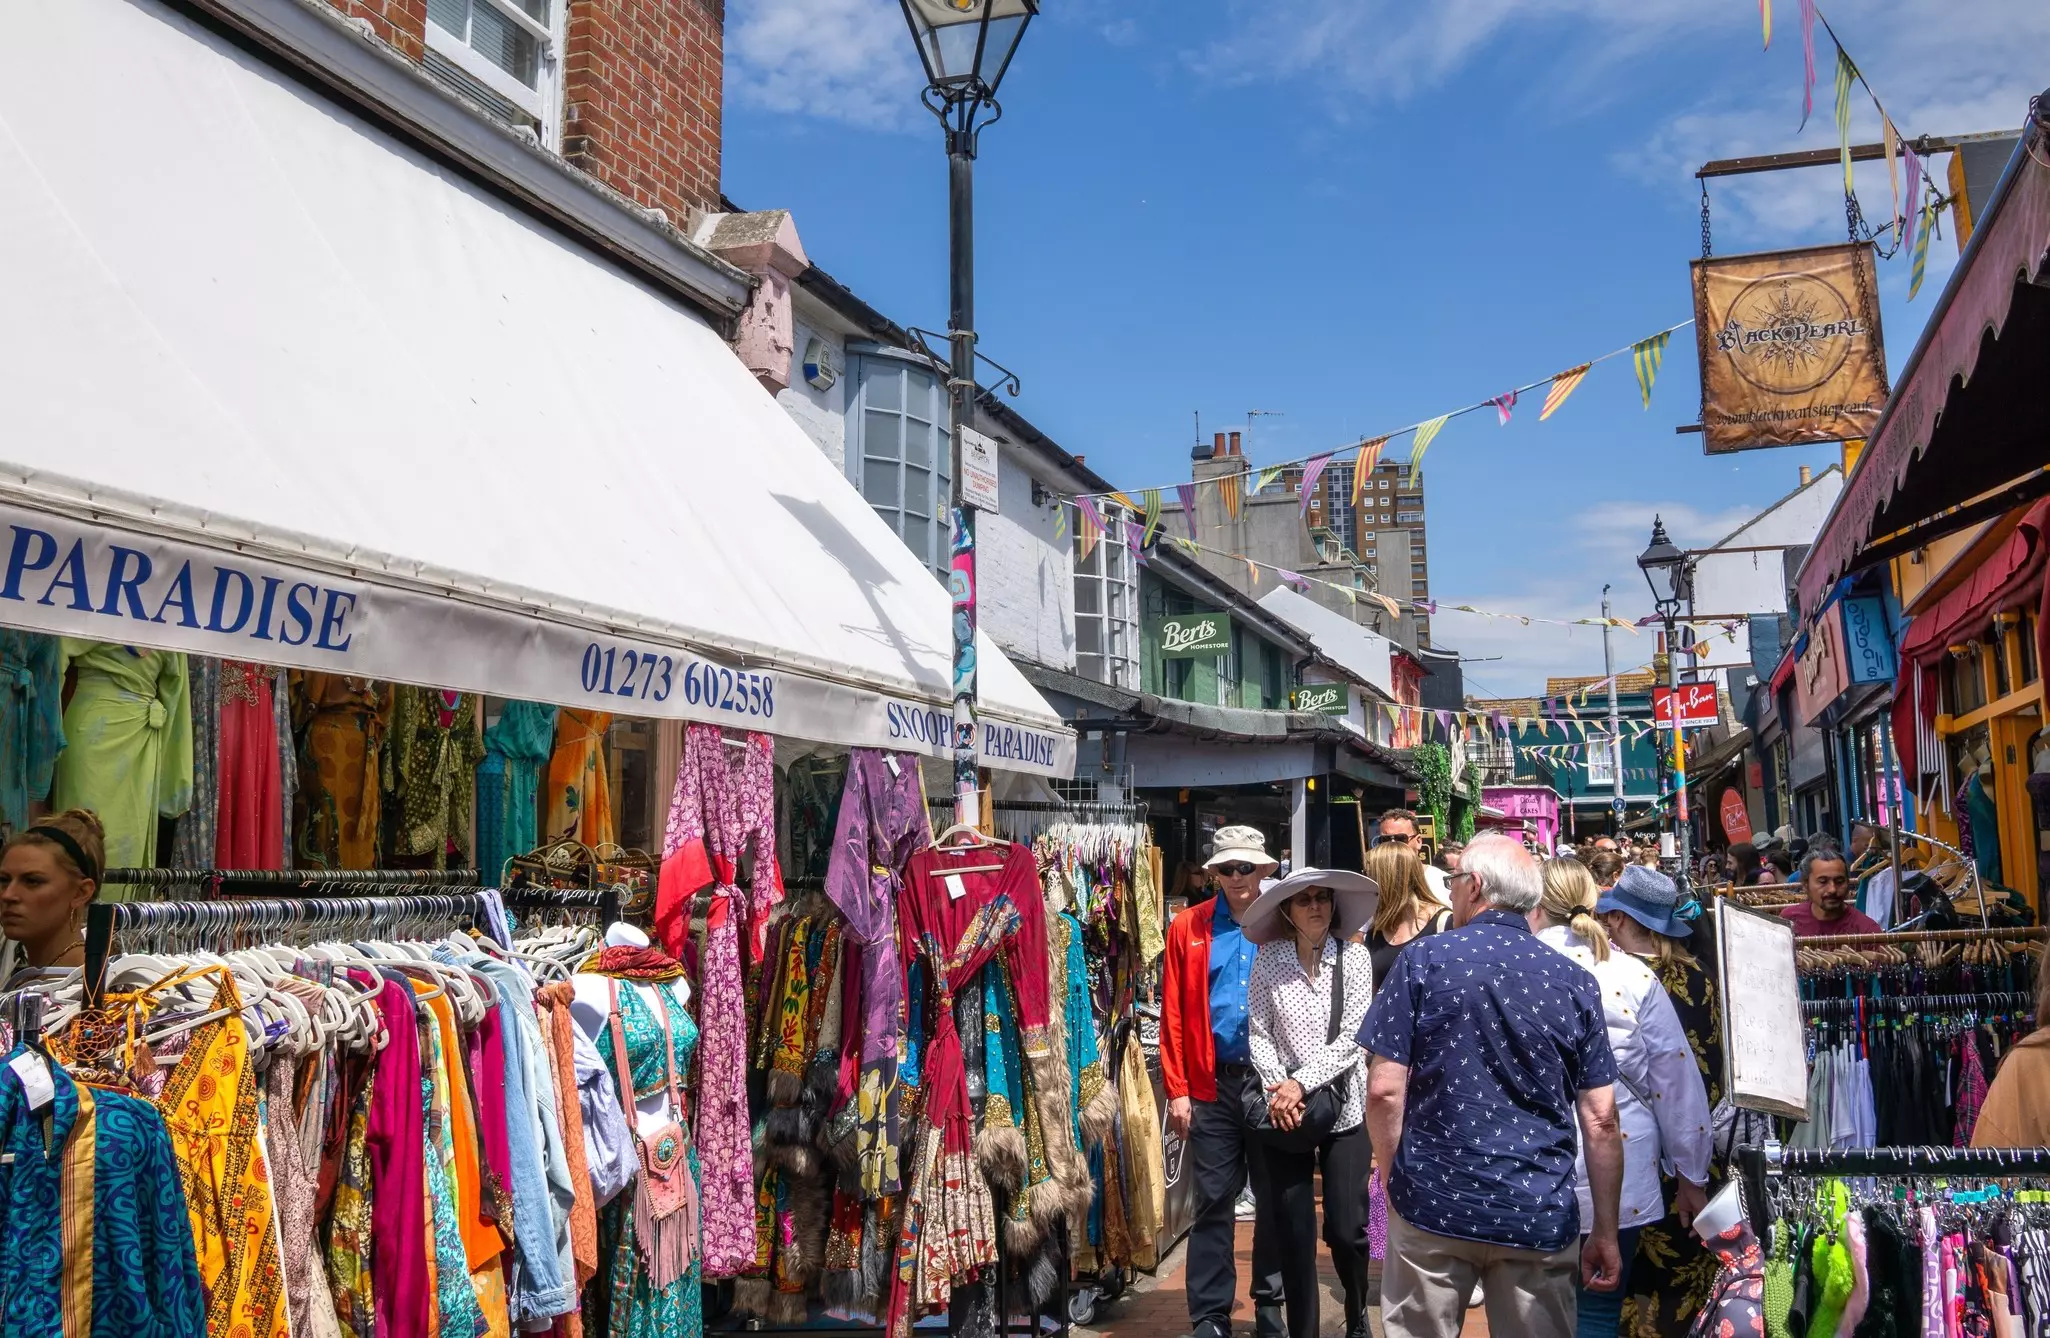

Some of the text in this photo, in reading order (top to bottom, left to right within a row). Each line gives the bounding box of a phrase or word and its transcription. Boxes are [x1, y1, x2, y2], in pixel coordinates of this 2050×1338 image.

[1717, 319, 1865, 354] BLACK PEARL
[0, 524, 357, 653] PARADISE
[1162, 620, 1216, 651] Bert's
[1190, 642, 1229, 650] HOMESTORE
[581, 642, 774, 718] 01273 602558
[1298, 688, 1339, 711] Bert's
[1656, 686, 1714, 718] Ry-Ban
[984, 723, 1055, 767] PARADISE
